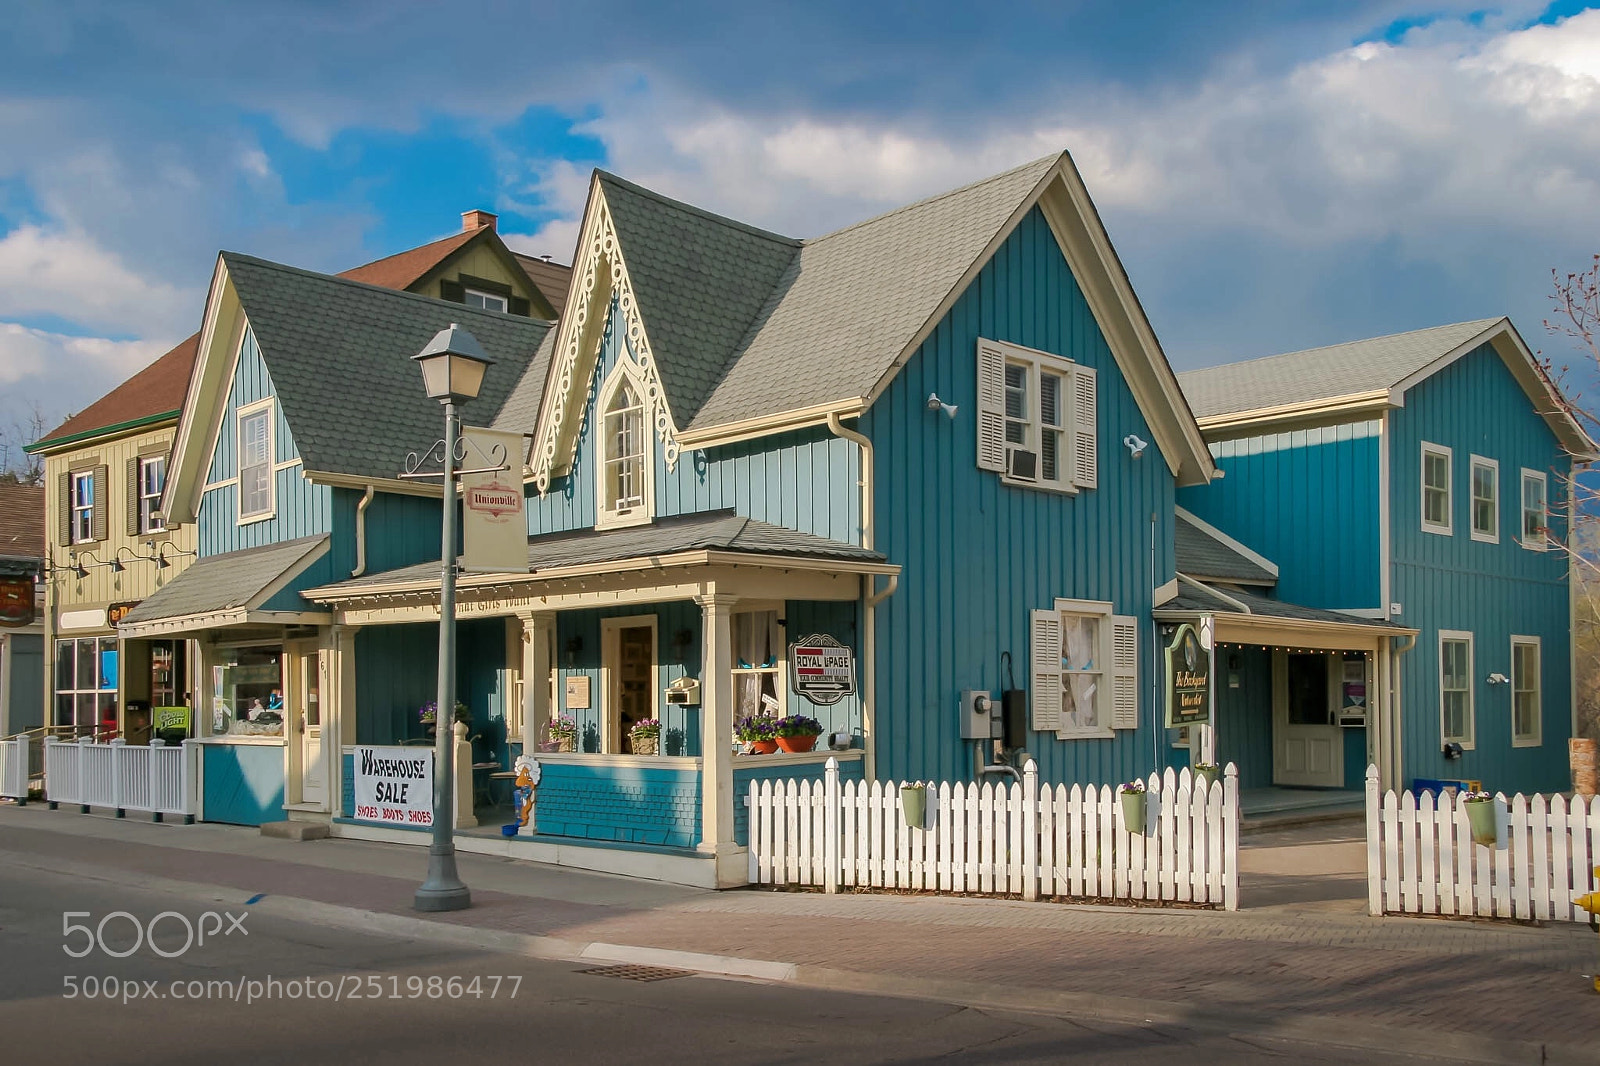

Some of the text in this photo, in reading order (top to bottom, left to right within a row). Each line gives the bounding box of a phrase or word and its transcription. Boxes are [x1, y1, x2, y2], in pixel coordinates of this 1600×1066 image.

[474, 493, 516, 506] Unionville
[797, 656, 822, 667] ROYAL
[160, 717, 185, 731] LIGHT
[361, 749, 425, 779] WAREHOUSE
[376, 782, 409, 804] SALE
[357, 805, 432, 823] SHOES BOOTS SHOES
